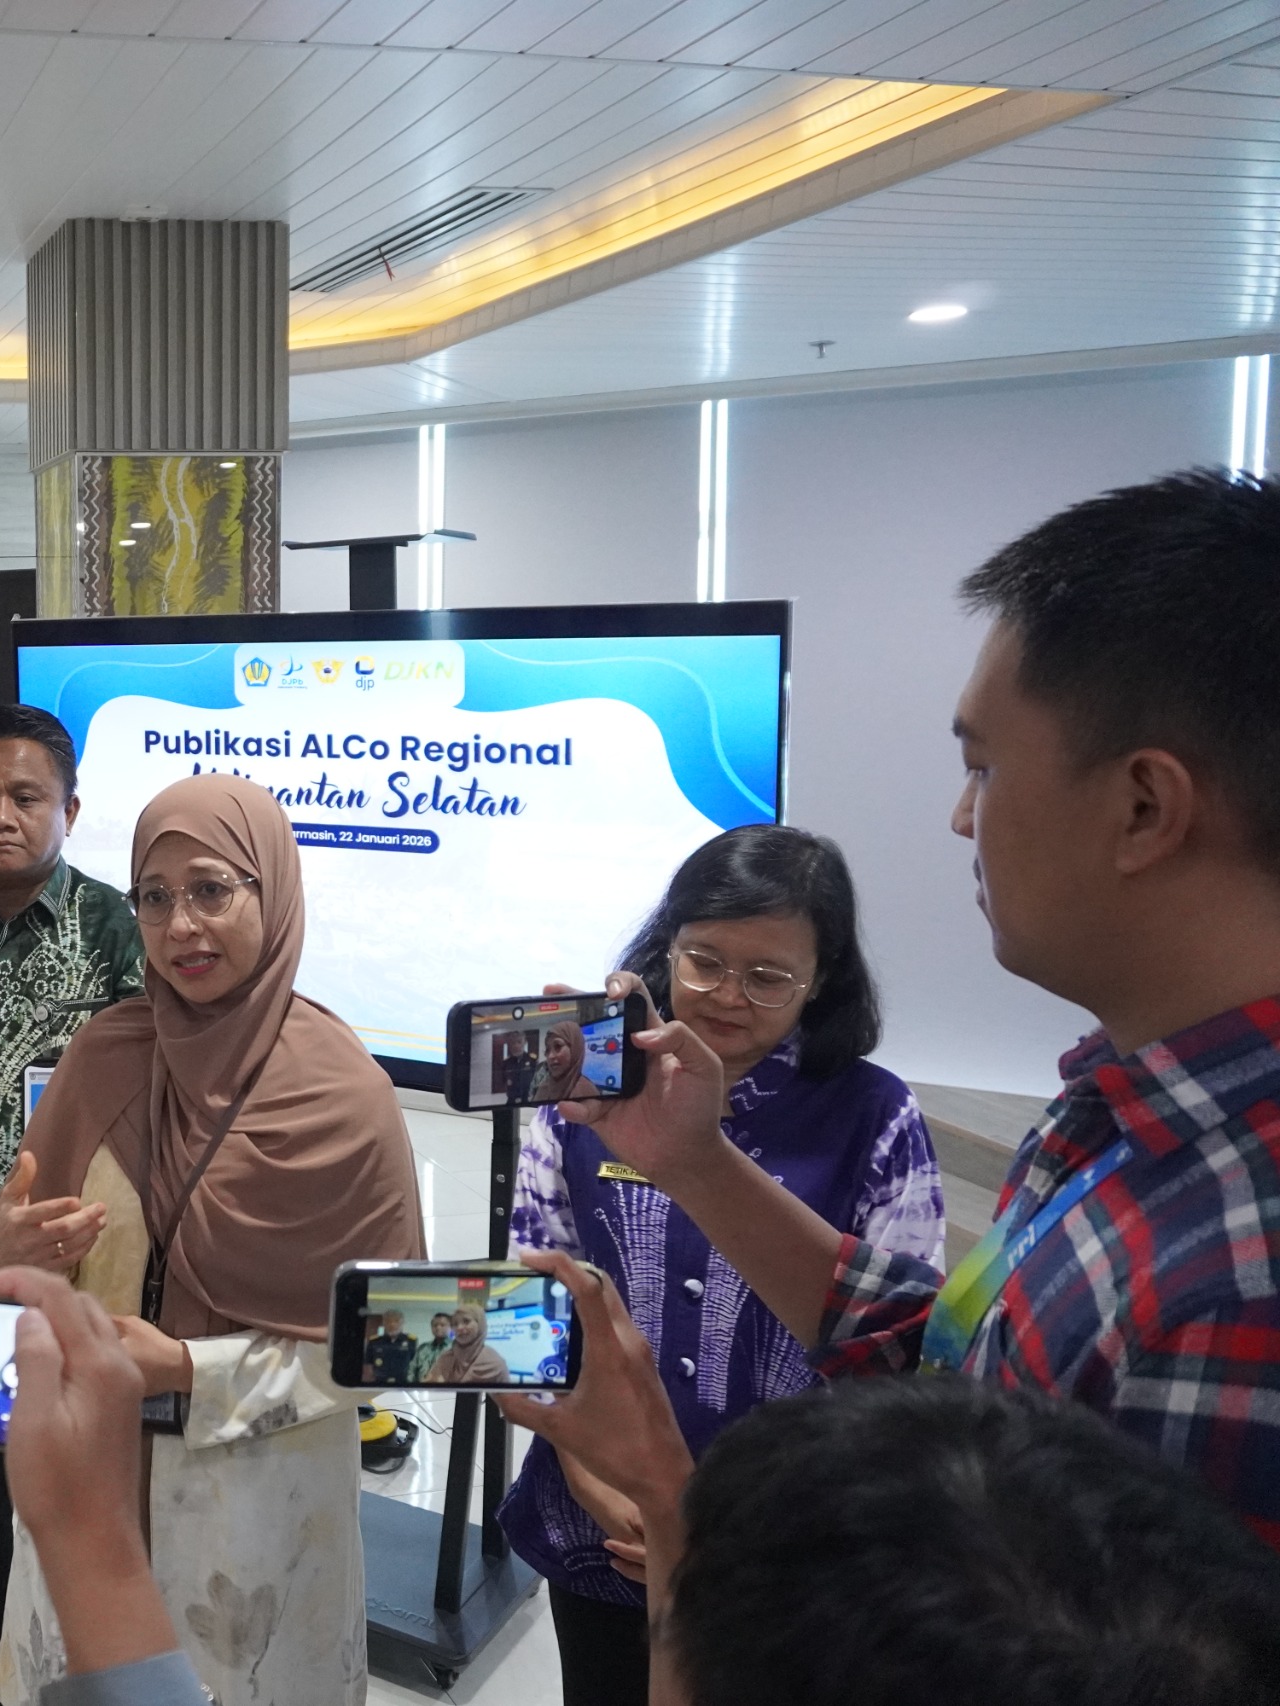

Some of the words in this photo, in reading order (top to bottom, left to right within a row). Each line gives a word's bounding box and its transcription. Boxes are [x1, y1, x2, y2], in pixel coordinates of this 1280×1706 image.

[384, 661, 455, 680] DJKN
[355, 675, 375, 691] djp
[145, 728, 291, 757] Publikasi
[300, 733, 390, 759] ALCo
[401, 733, 572, 772] Regional
[382, 771, 527, 818] Selatan
[339, 831, 353, 842] 22
[355, 833, 400, 845] Januari
[402, 835, 432, 847] 2026
[605, 1165, 628, 1175] TETIK
